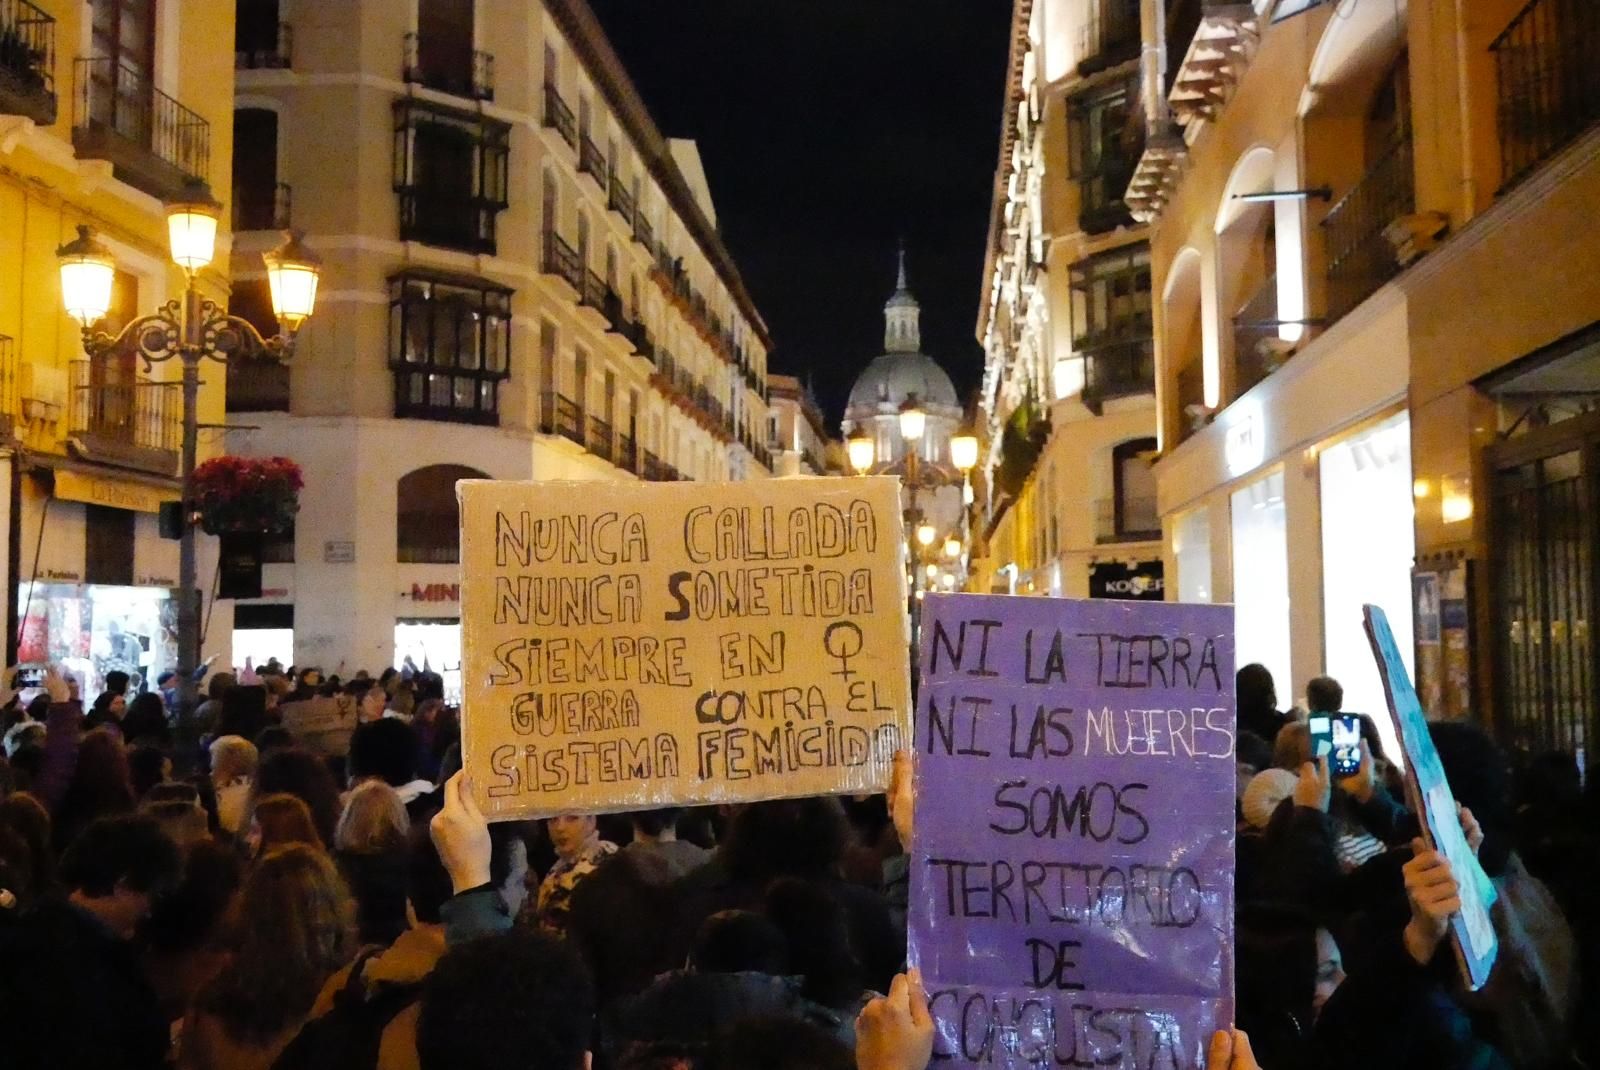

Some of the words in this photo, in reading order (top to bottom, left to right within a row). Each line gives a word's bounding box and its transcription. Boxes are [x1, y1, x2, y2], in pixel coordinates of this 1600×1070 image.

[495, 511, 648, 567] NUNCA
[685, 499, 877, 564] CALLADA
[494, 574, 643, 626] NUNCA
[720, 631, 785, 680] EN
[930, 619, 1003, 677] NI
[1025, 628, 1067, 684] LA
[1077, 633, 1222, 690] TIERRA
[511, 689, 640, 736] GUERRA
[695, 686, 827, 724] CONTRA
[846, 681, 893, 712] EL
[928, 696, 993, 757] NI
[1009, 703, 1074, 760] LAS
[1084, 707, 1235, 760] MUJERES
[989, 781, 1150, 845] SOMOS
[926, 859, 1201, 929] TERRITORIO
[1024, 938, 1086, 991] DE
